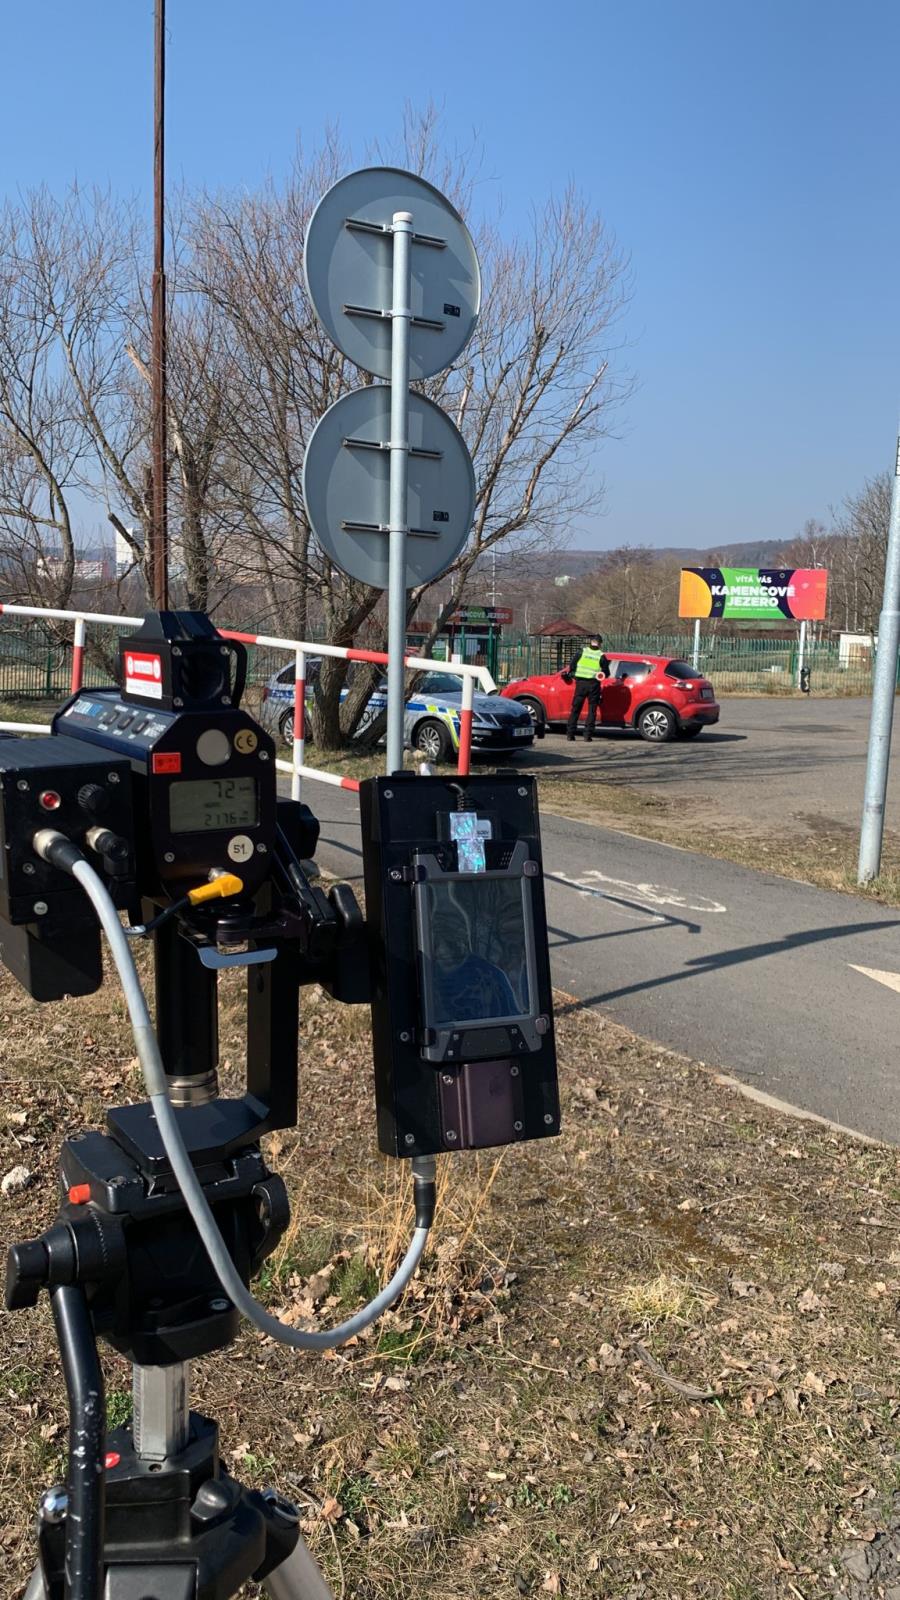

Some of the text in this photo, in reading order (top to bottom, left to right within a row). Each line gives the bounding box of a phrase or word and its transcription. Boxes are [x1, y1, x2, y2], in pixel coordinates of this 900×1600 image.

[735, 575, 772, 584] VÍTÁ VÁS
[711, 585, 796, 596] KAMENCOVÉ
[727, 597, 779, 607] JEZERO
[212, 780, 236, 799] 72
[233, 843, 246, 855] 51
